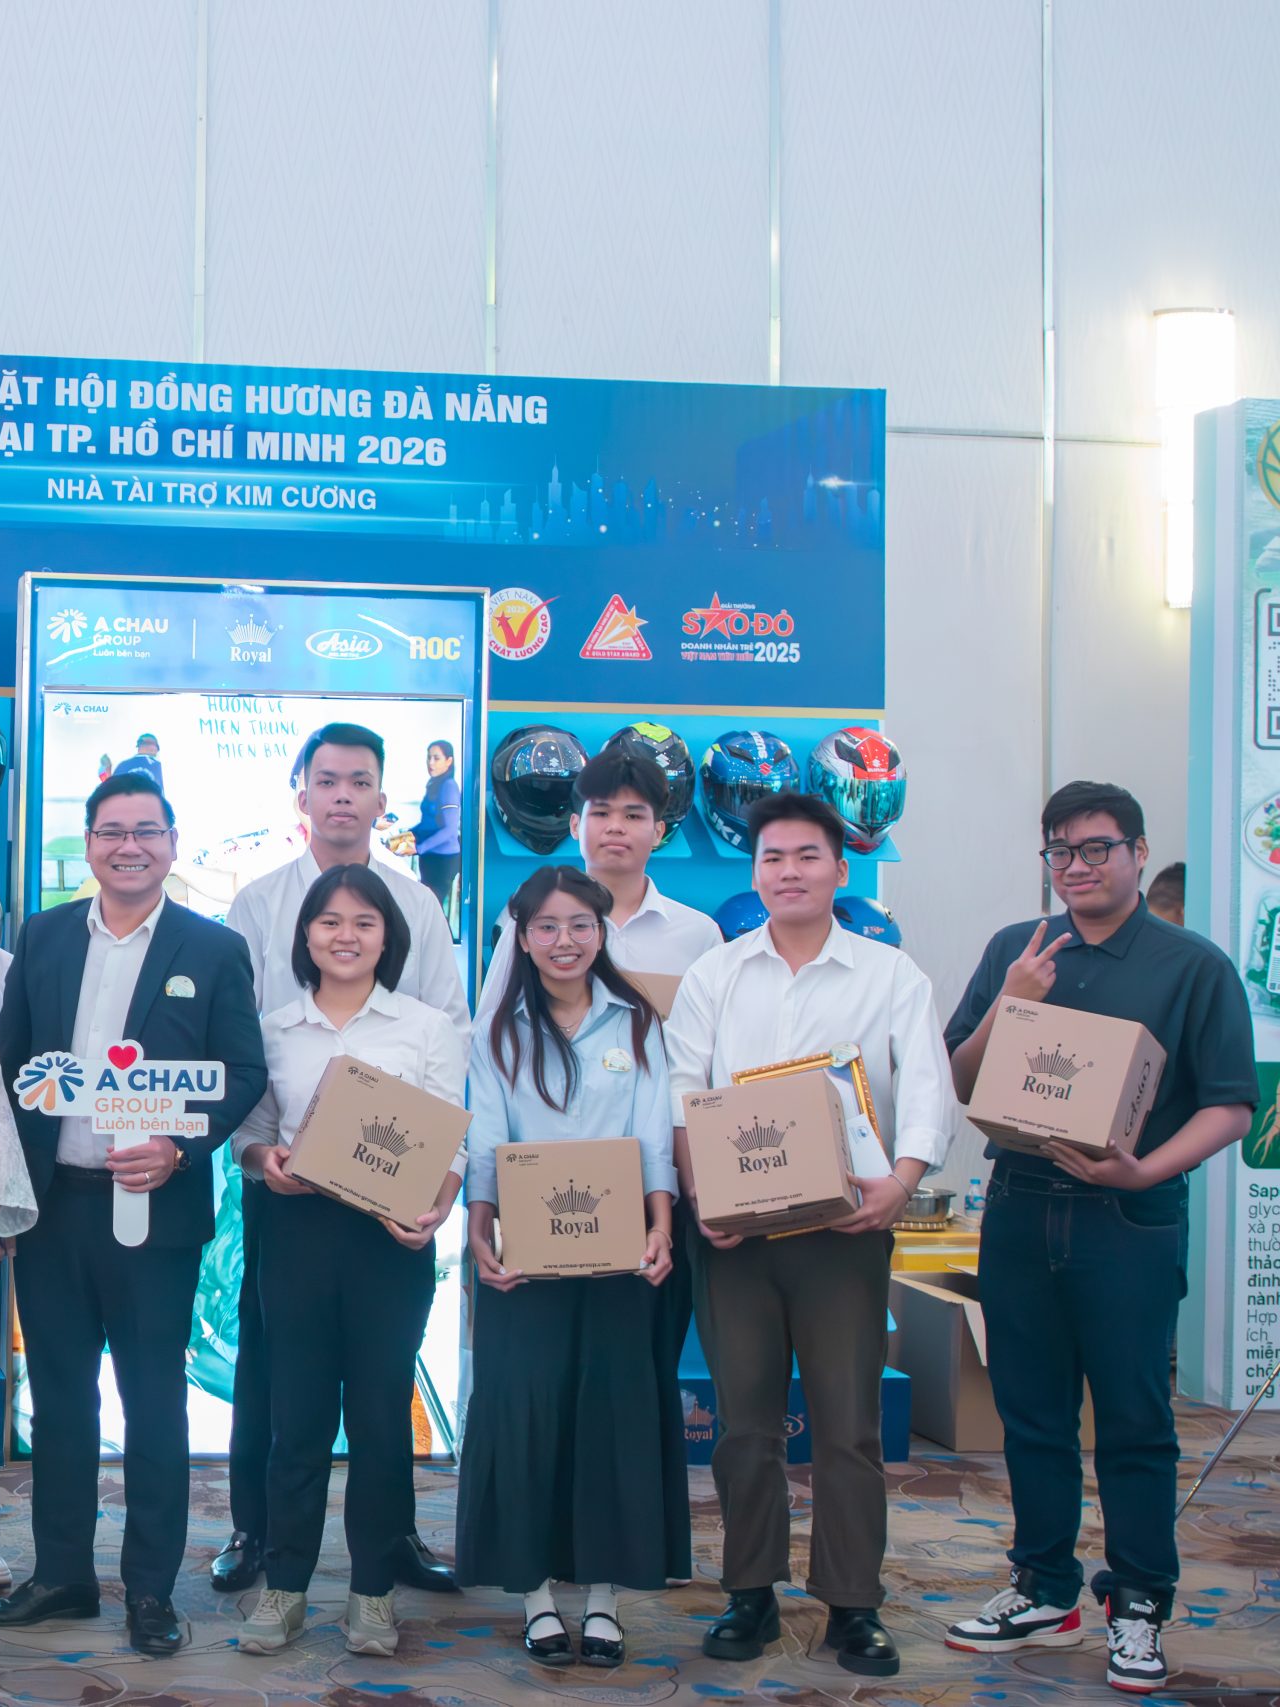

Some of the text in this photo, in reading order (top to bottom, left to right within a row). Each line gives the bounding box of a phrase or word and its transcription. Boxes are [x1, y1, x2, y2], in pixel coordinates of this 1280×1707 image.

[55, 372, 117, 414] HỘI
[128, 372, 233, 414] ĐỒNG
[245, 384, 371, 418] HƯƠNG
[383, 386, 434, 420] ĐÀ
[445, 383, 548, 425] NẴNG
[47, 423, 97, 454] TP.
[109, 417, 159, 456] HỒ
[171, 424, 234, 459] CHÍ
[246, 431, 345, 463] MINH
[357, 435, 447, 467] 2026
[47, 474, 377, 511] NHÀ TÀI TRỢ KIM CƯƠNG
[93, 616, 169, 633] A CHAU
[751, 609, 795, 637] ĐỎ
[93, 634, 142, 646] GROUP
[316, 632, 373, 653] Asia
[409, 635, 462, 661] ROC
[93, 648, 115, 657] Luôn
[116, 648, 133, 657] bên
[230, 646, 272, 665] Royal
[754, 641, 801, 663] 2025
[83, 705, 109, 713] CHAU
[95, 1068, 218, 1093] A CHAU
[1022, 1074, 1073, 1101] Royal
[94, 1097, 173, 1114] GROUP
[95, 1116, 205, 1134] Luôn bên bạn
[351, 1142, 401, 1178] Royal
[737, 1149, 789, 1174] Royal
[1248, 1183, 1280, 1201] Sap
[549, 1216, 599, 1239] Royal
[1247, 1220, 1265, 1234] xà
[1247, 1309, 1278, 1327] Hợp
[1246, 1327, 1268, 1342] ích
[1246, 1359, 1280, 1378] chố
